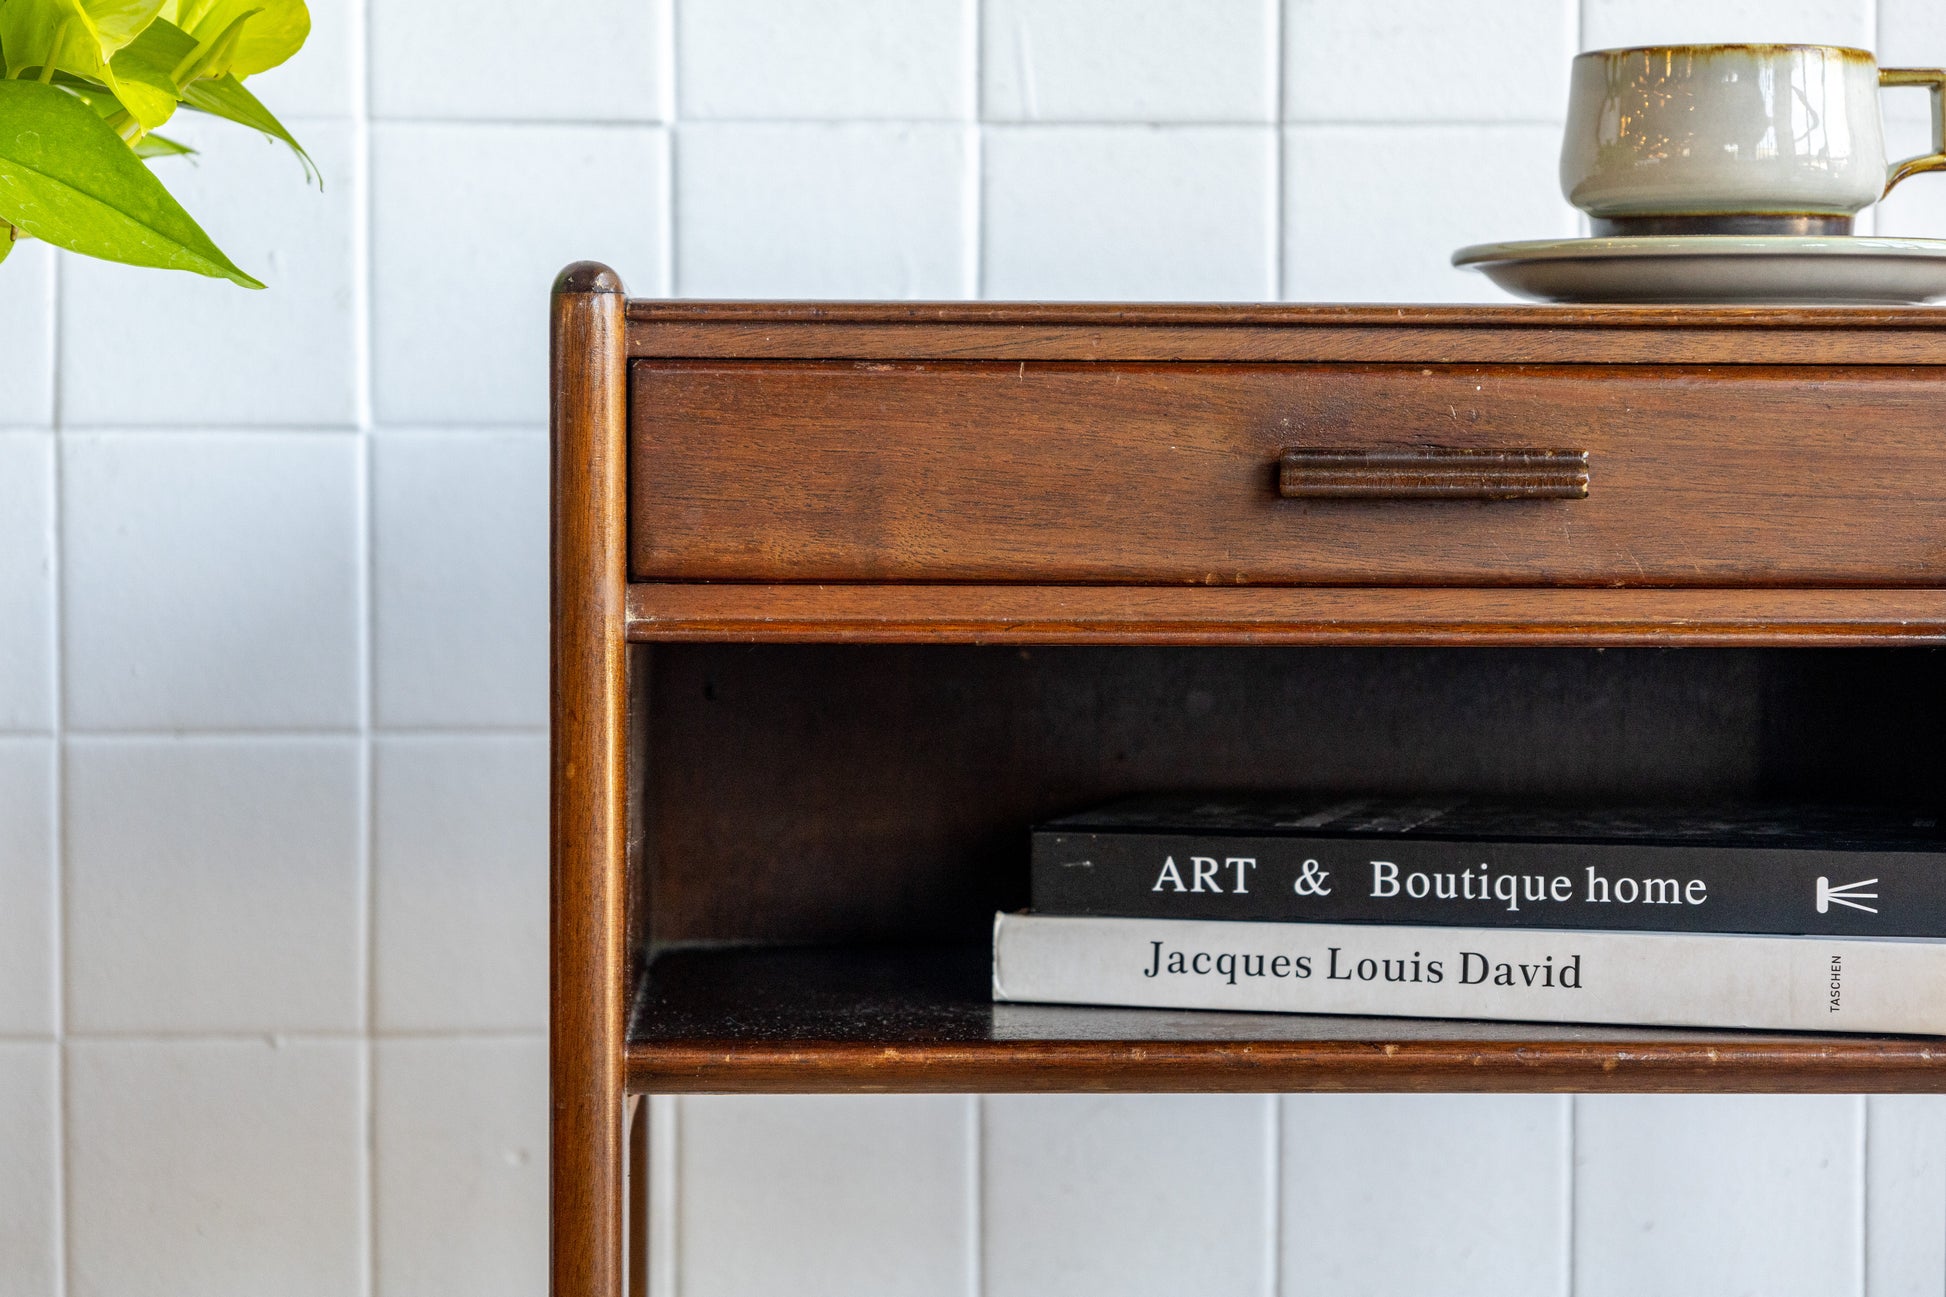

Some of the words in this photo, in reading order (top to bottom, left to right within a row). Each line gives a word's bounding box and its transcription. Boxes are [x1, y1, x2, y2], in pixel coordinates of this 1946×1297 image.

[1152, 855, 1258, 894] ART
[1294, 859, 1332, 896] &
[1369, 861, 1573, 911] Boutique
[1585, 865, 1709, 906] home
[1143, 941, 1312, 985] Jacques
[1326, 947, 1444, 984] Louis
[1458, 951, 1583, 989] David
[1829, 955, 1842, 1013] TASCHEN
